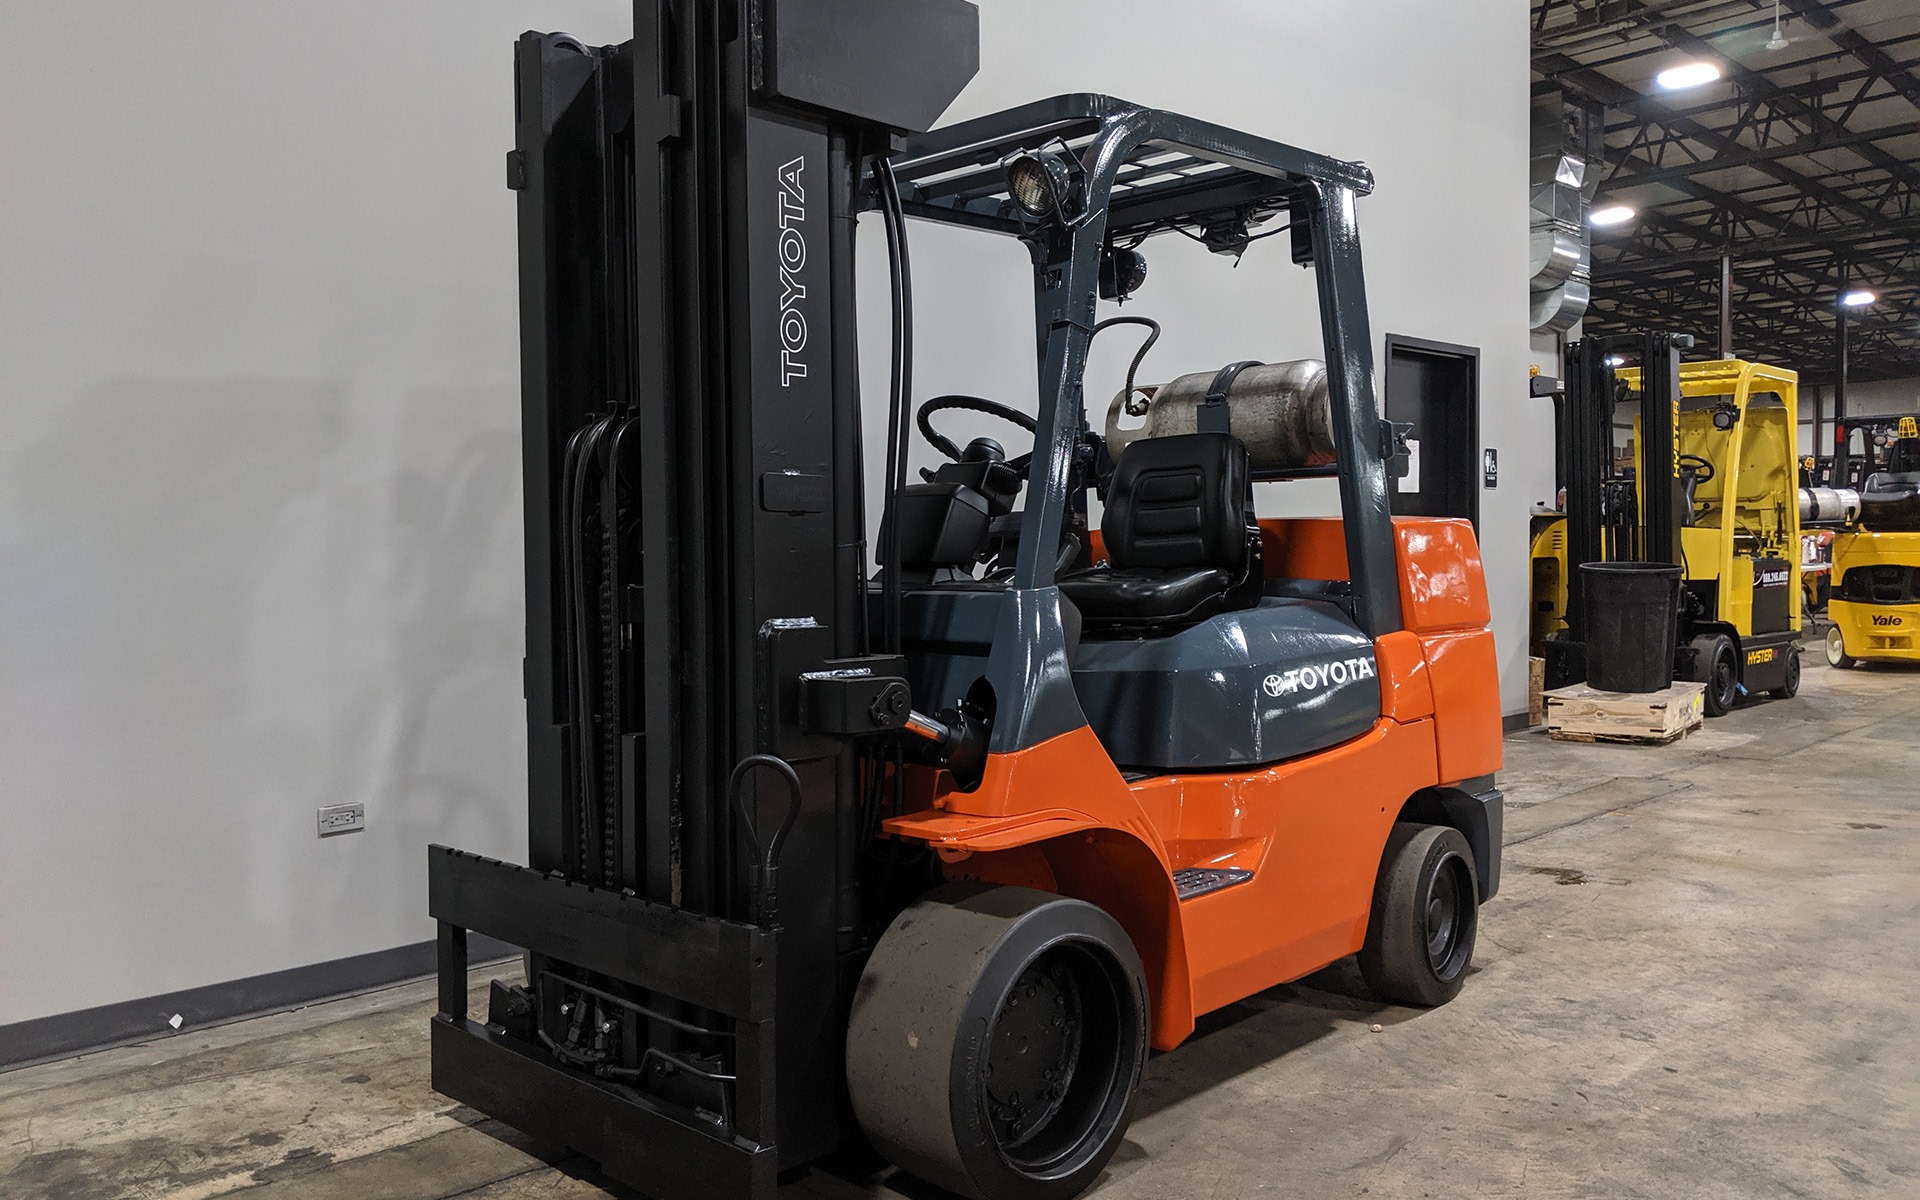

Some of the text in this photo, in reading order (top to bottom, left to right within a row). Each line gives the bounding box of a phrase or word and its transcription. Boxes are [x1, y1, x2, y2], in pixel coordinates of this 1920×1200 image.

[778, 155, 808, 387] TOYOTA
[1672, 400, 1680, 478] HYSTER
[1871, 614, 1903, 626] Yale
[1283, 656, 1375, 693] TOYOTA
[1747, 648, 1773, 665] HYSTER
